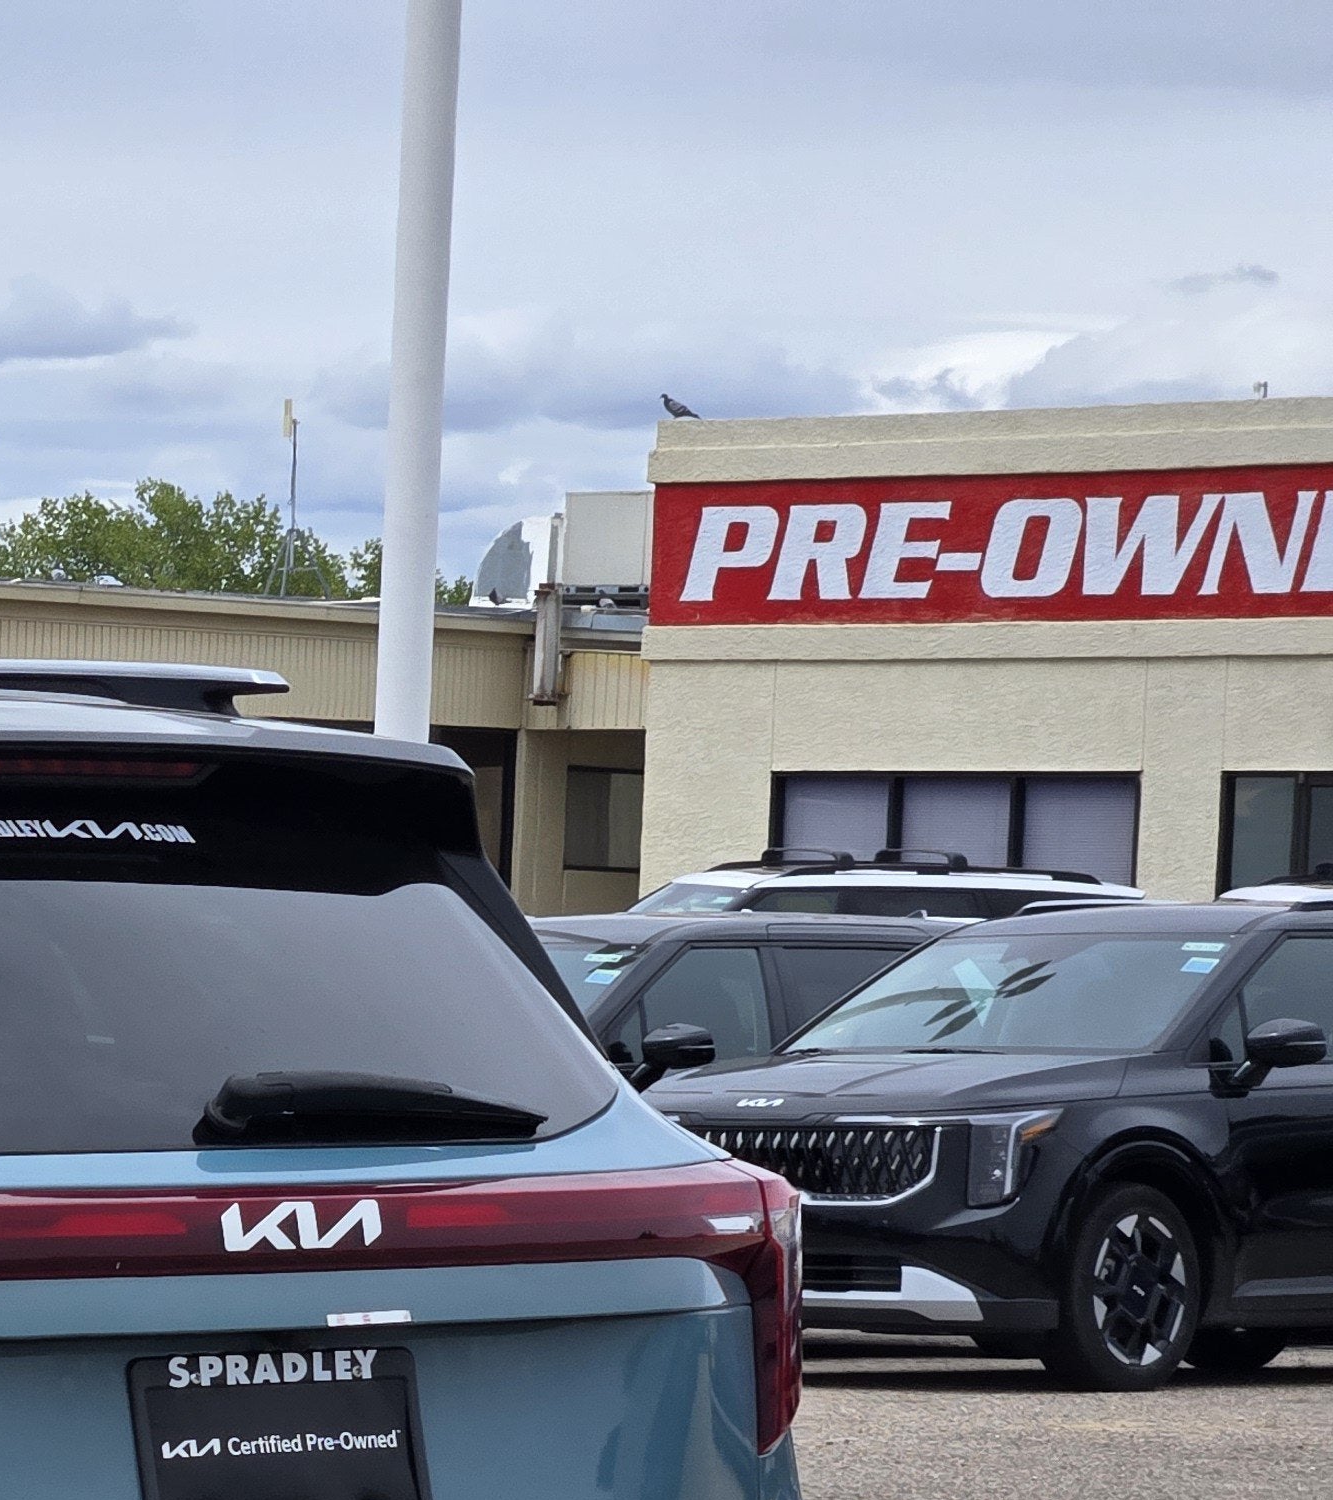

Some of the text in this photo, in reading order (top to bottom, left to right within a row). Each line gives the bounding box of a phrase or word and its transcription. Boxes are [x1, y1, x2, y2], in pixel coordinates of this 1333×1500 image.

[220, 1199, 382, 1252] KIA
[167, 1349, 378, 1389] SPRADLEY
[161, 1430, 398, 1460] KIA Certified Pre-Owned
